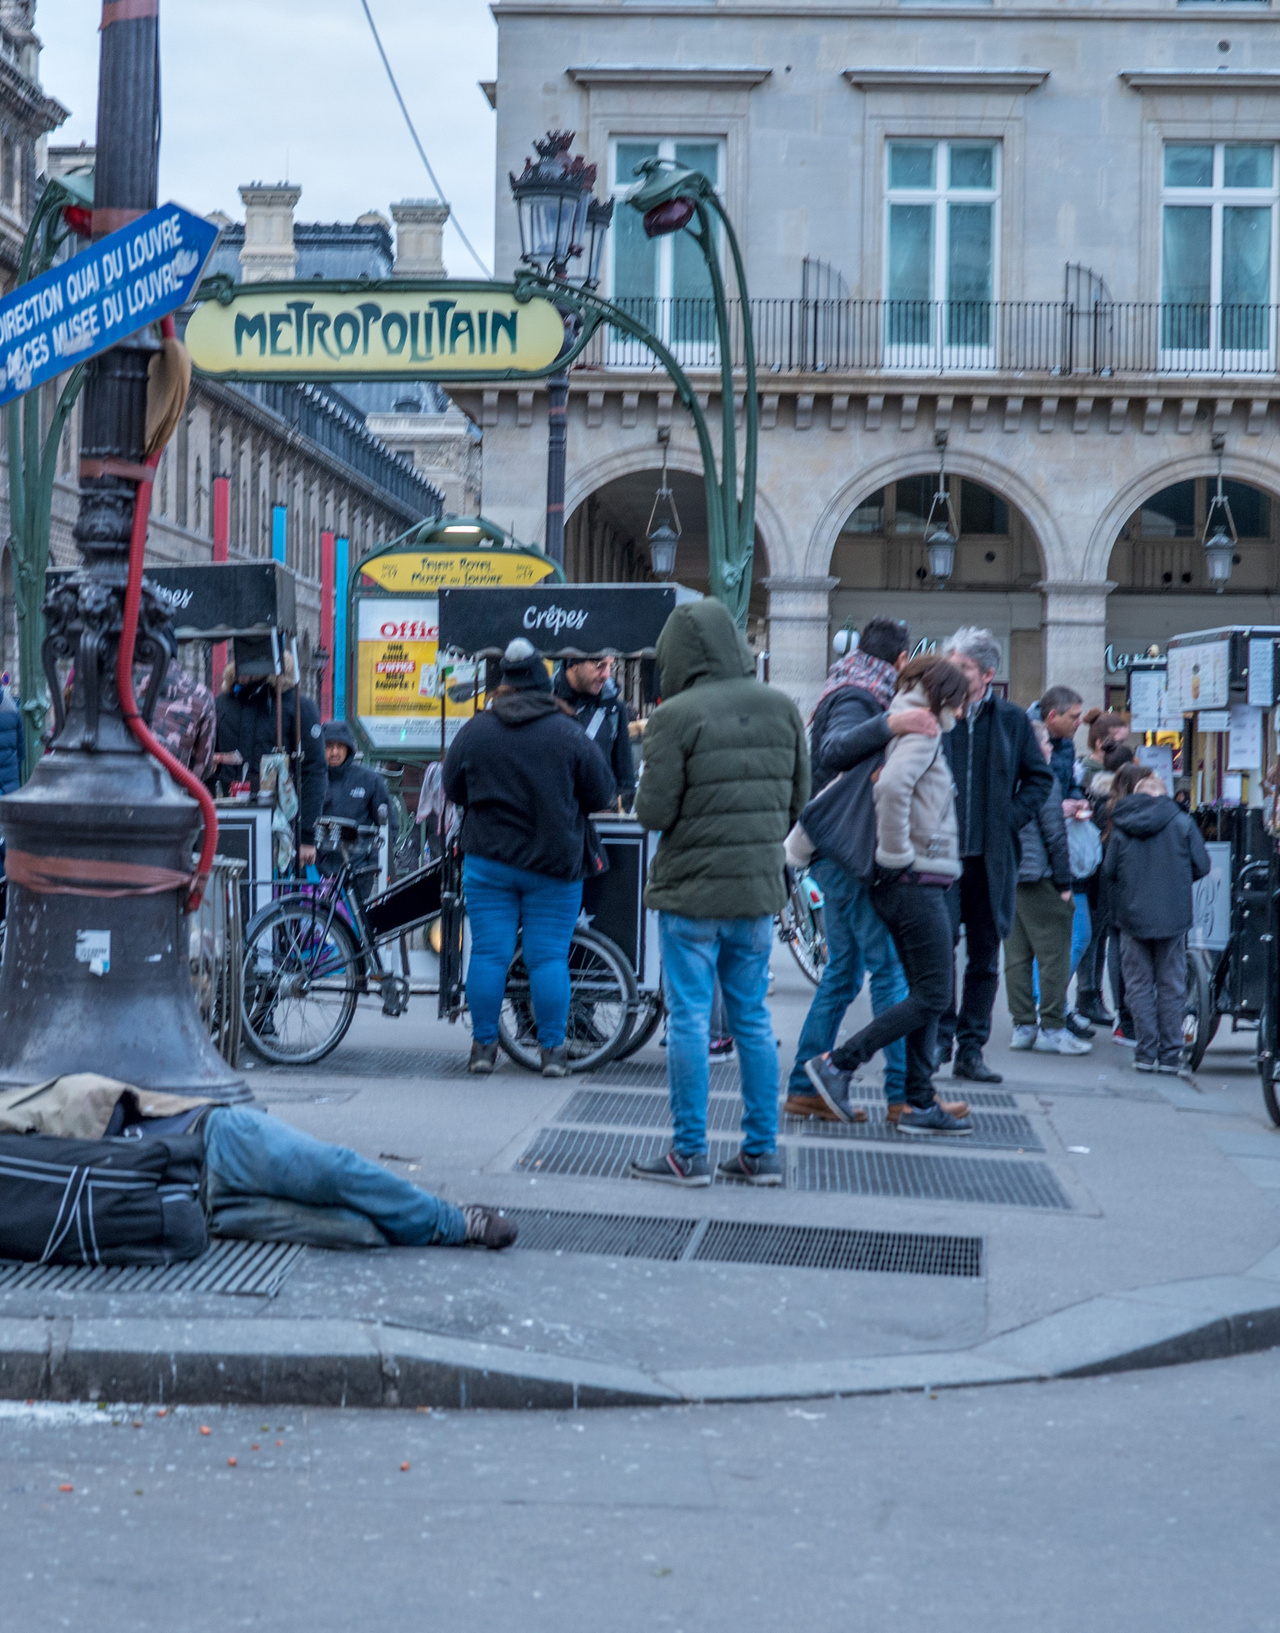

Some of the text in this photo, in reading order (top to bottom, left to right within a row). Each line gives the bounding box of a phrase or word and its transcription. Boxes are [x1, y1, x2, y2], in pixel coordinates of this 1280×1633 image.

[67, 260, 100, 305] QUAI
[102, 247, 124, 285] DU
[125, 212, 183, 272] LOUVRE
[52, 304, 100, 355] MUSEE
[102, 294, 124, 329] DU
[234, 299, 519, 363] METROPOLITAIN
[380, 620, 439, 639] Offic
[523, 604, 589, 636] Crêpes
